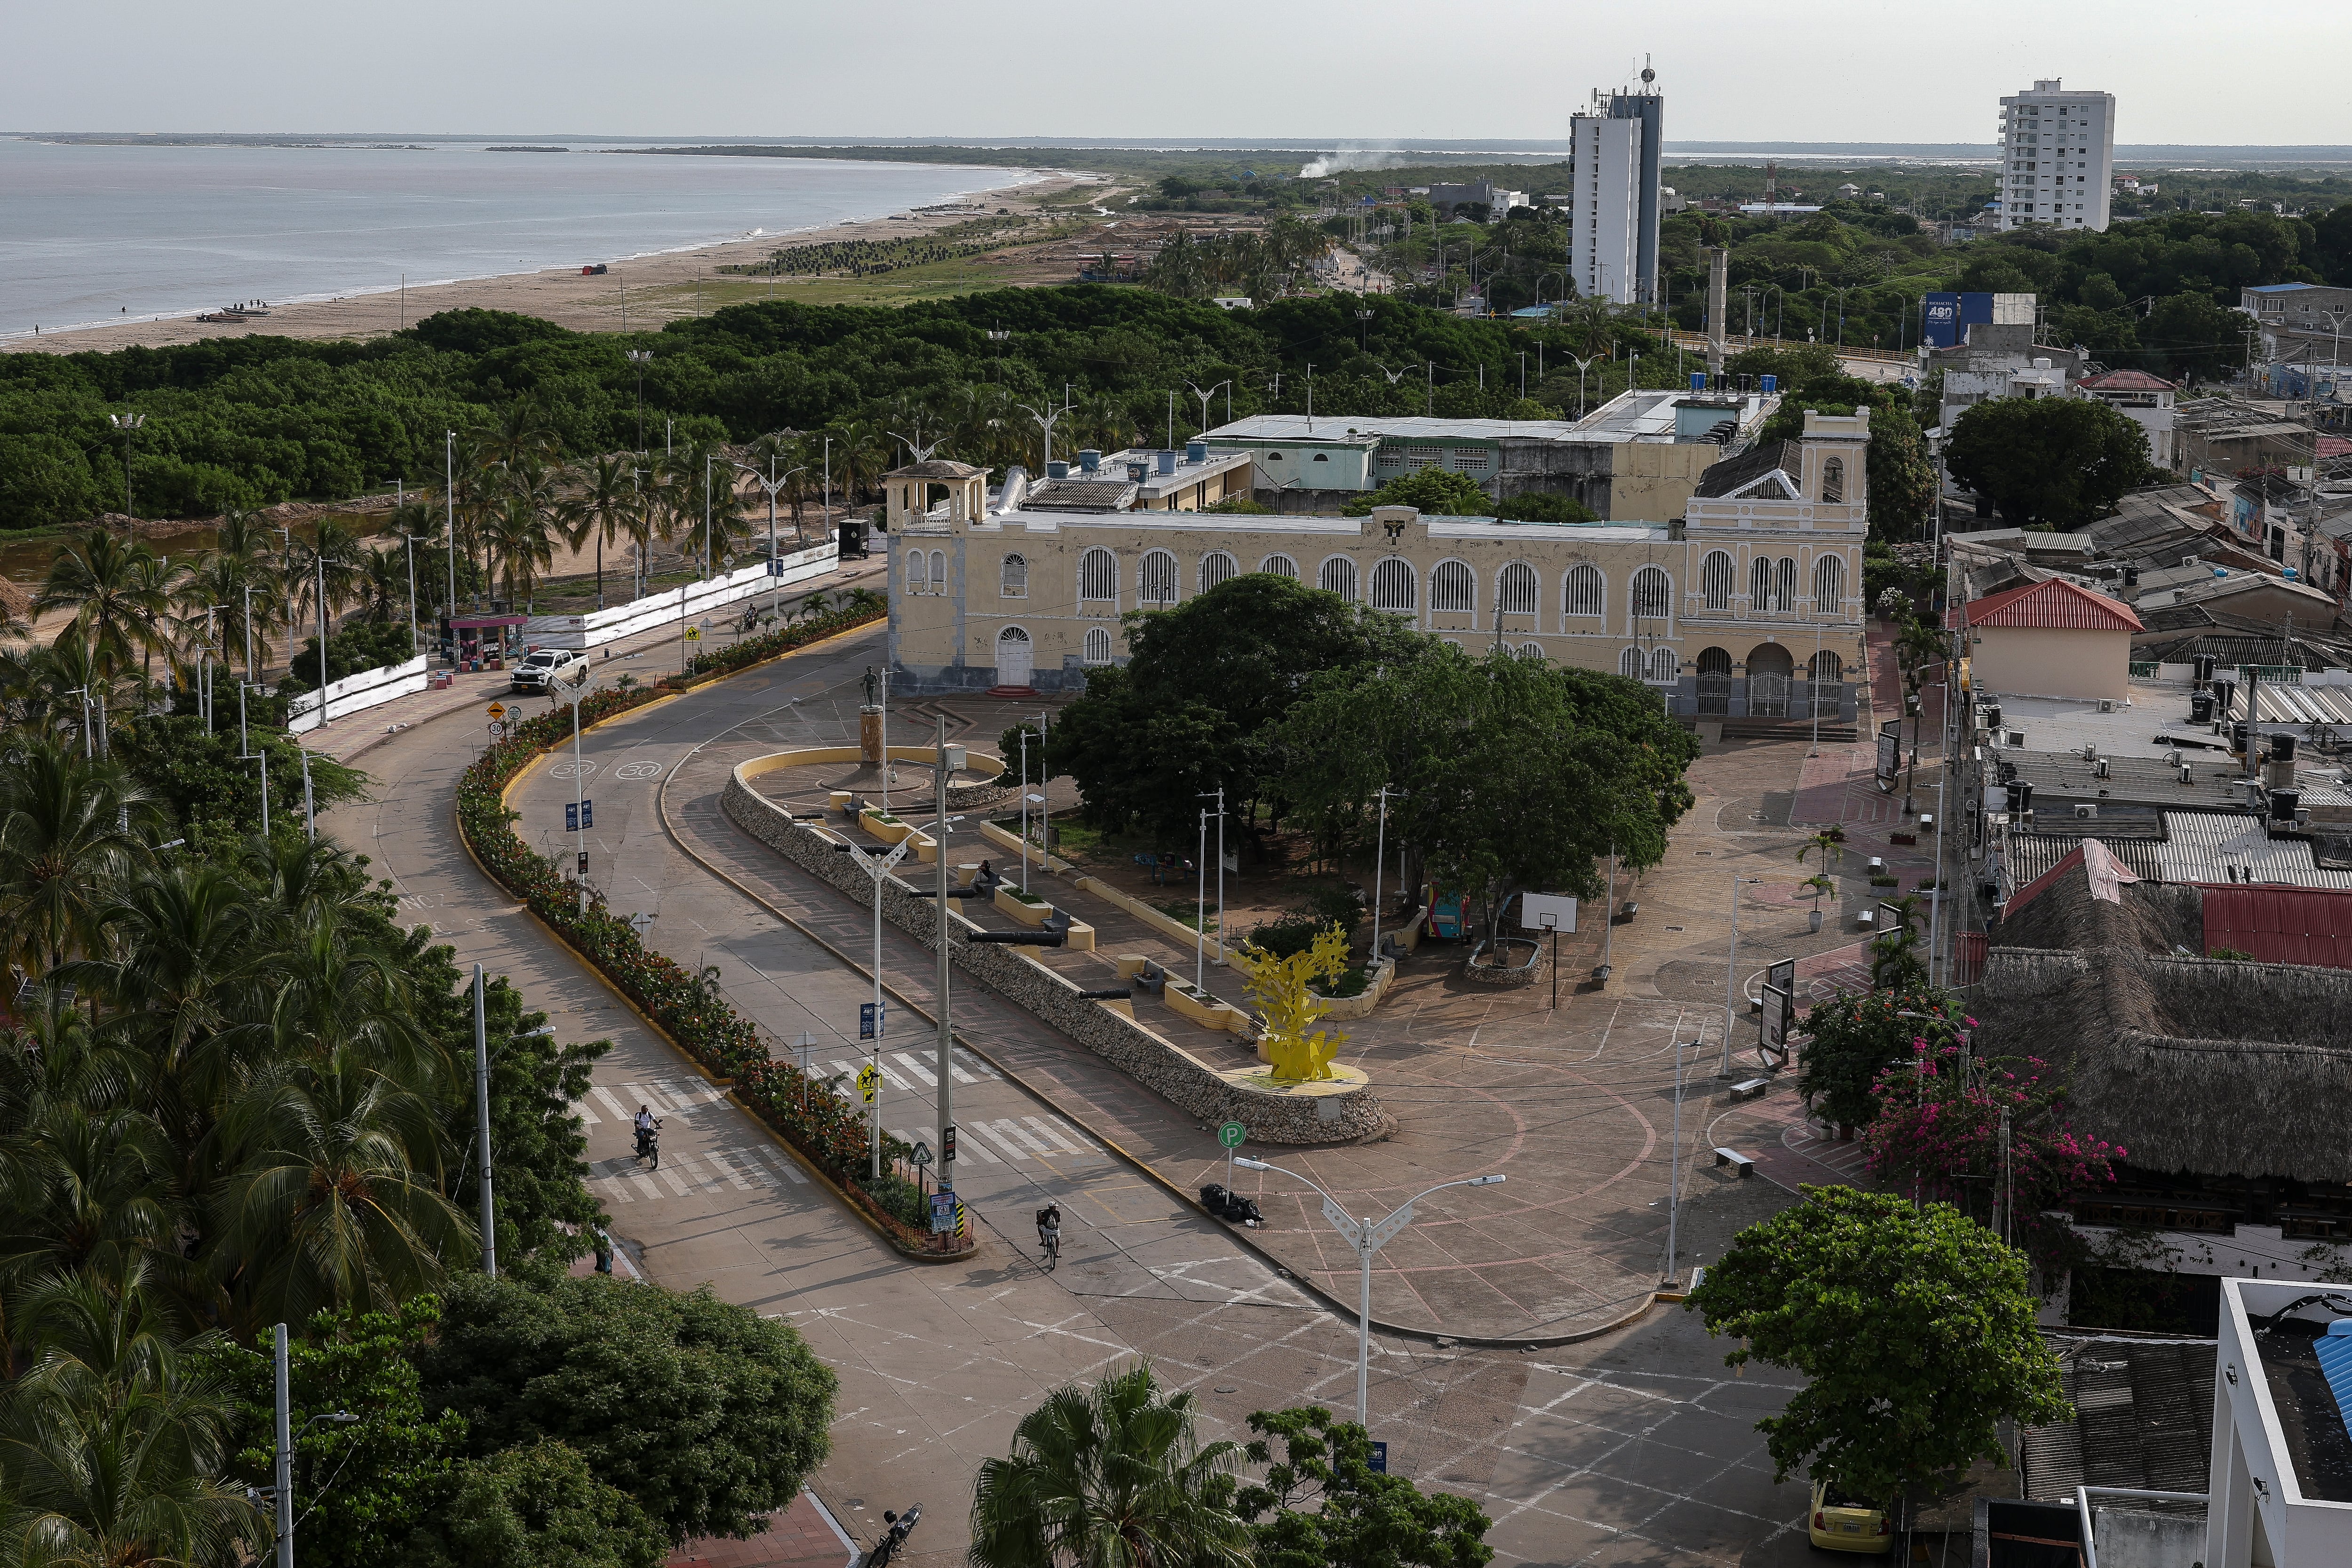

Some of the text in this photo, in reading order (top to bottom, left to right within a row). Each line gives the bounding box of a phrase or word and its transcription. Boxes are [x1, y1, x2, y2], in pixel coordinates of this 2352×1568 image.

[1929, 306, 1952, 317] 480
[484, 642, 499, 652] EFEC
[555, 764, 590, 774] 30
[620, 766, 656, 776] 30
